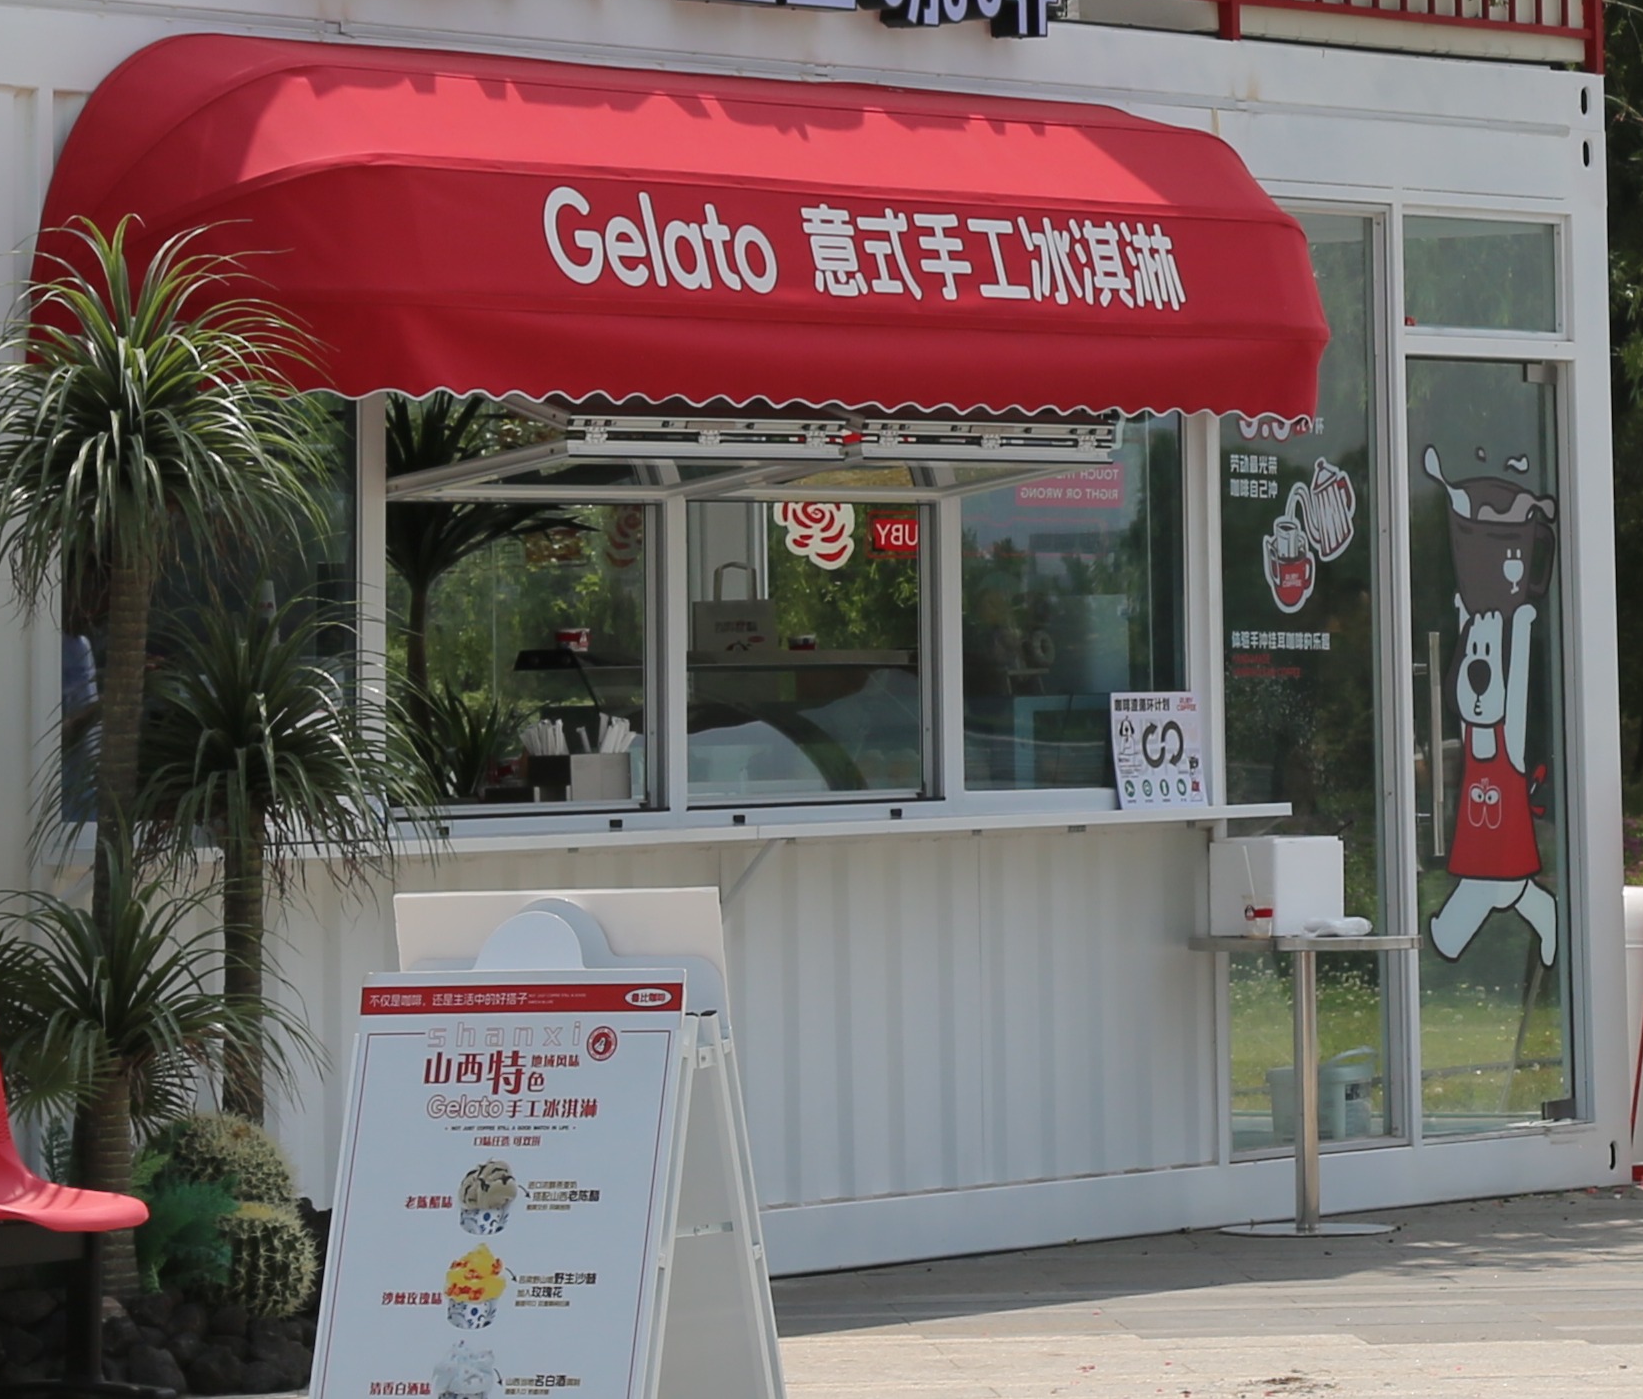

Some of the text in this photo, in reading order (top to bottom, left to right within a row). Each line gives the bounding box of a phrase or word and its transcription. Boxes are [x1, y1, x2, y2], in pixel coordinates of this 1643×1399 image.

[542, 185, 778, 294] Gelato
[801, 203, 1187, 311] 意式手工冰淇淋
[1230, 454, 1277, 474] 劳动最光荣
[1230, 478, 1278, 498] 咖啡自己冲
[427, 1021, 582, 1048] shanxi
[530, 1054, 580, 1068] 地域风味
[427, 1094, 504, 1119] Gelato
[506, 1098, 598, 1119] 手工冰淇淋
